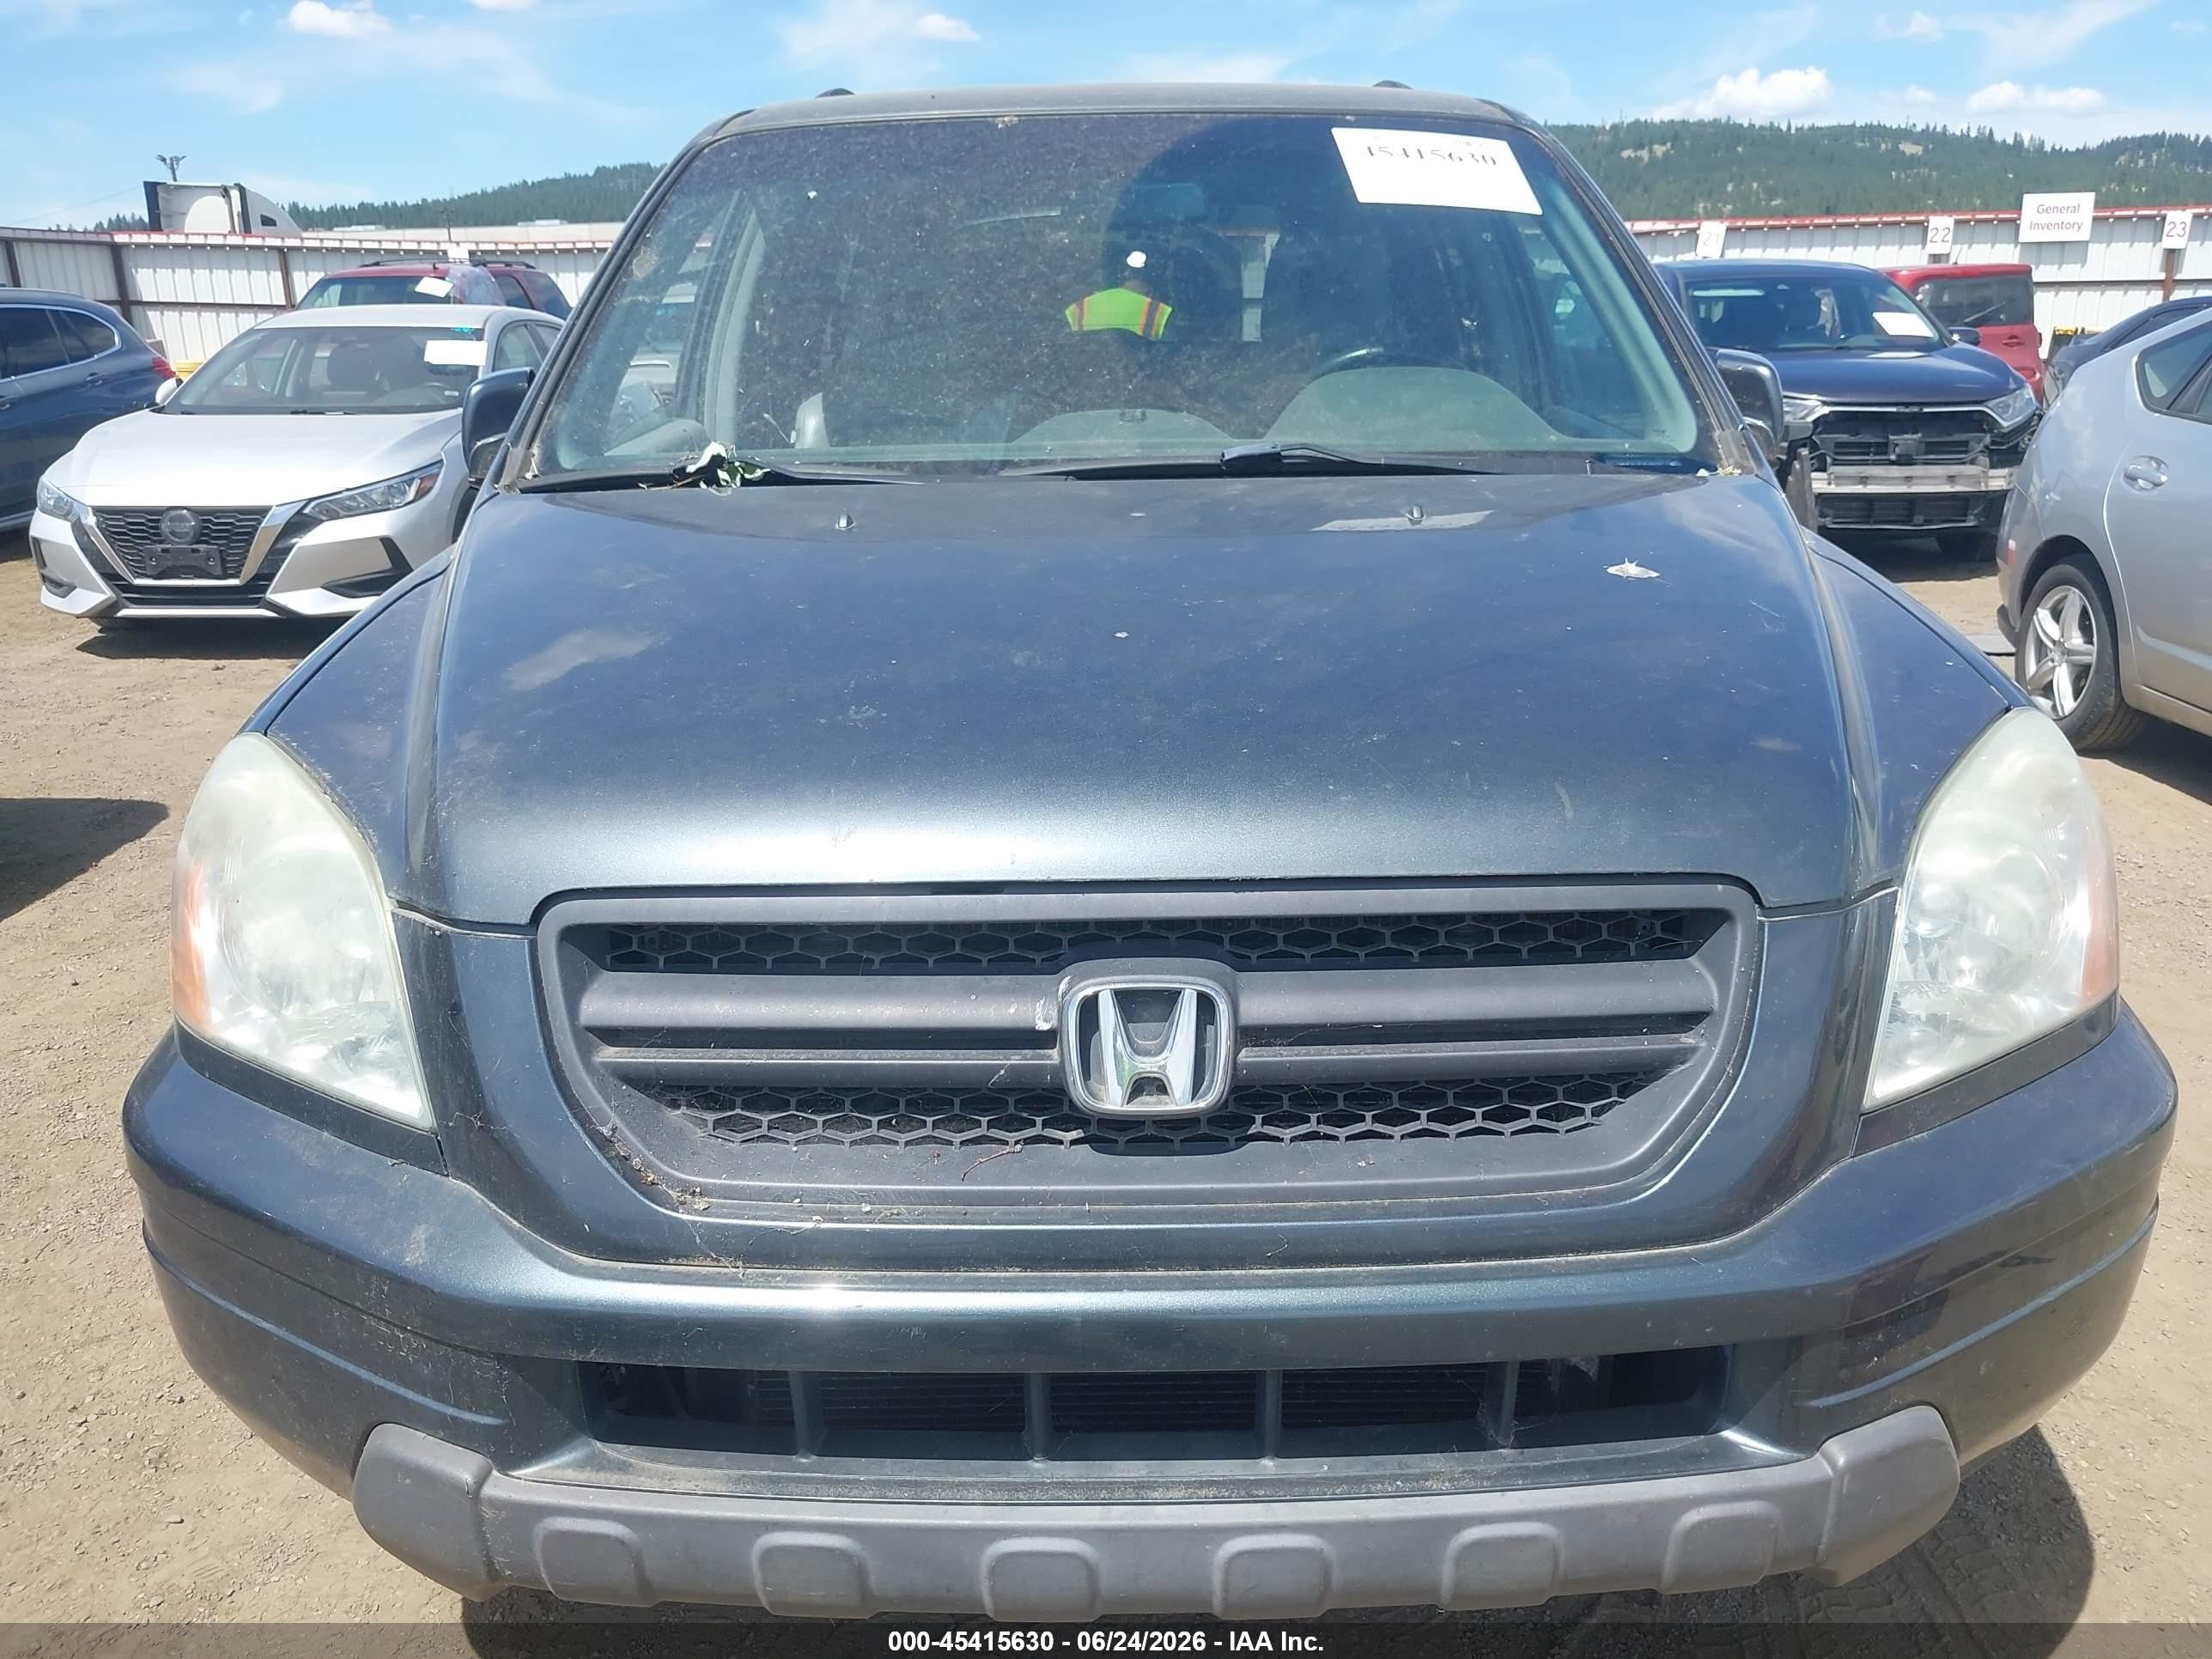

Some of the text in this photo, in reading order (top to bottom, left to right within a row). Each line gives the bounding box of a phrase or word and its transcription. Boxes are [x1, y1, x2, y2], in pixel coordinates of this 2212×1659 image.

[2036, 203, 2081, 215] General
[2029, 220, 2083, 233] Inventory
[2166, 221, 2187, 238] 23
[1929, 227, 1951, 243] 22
